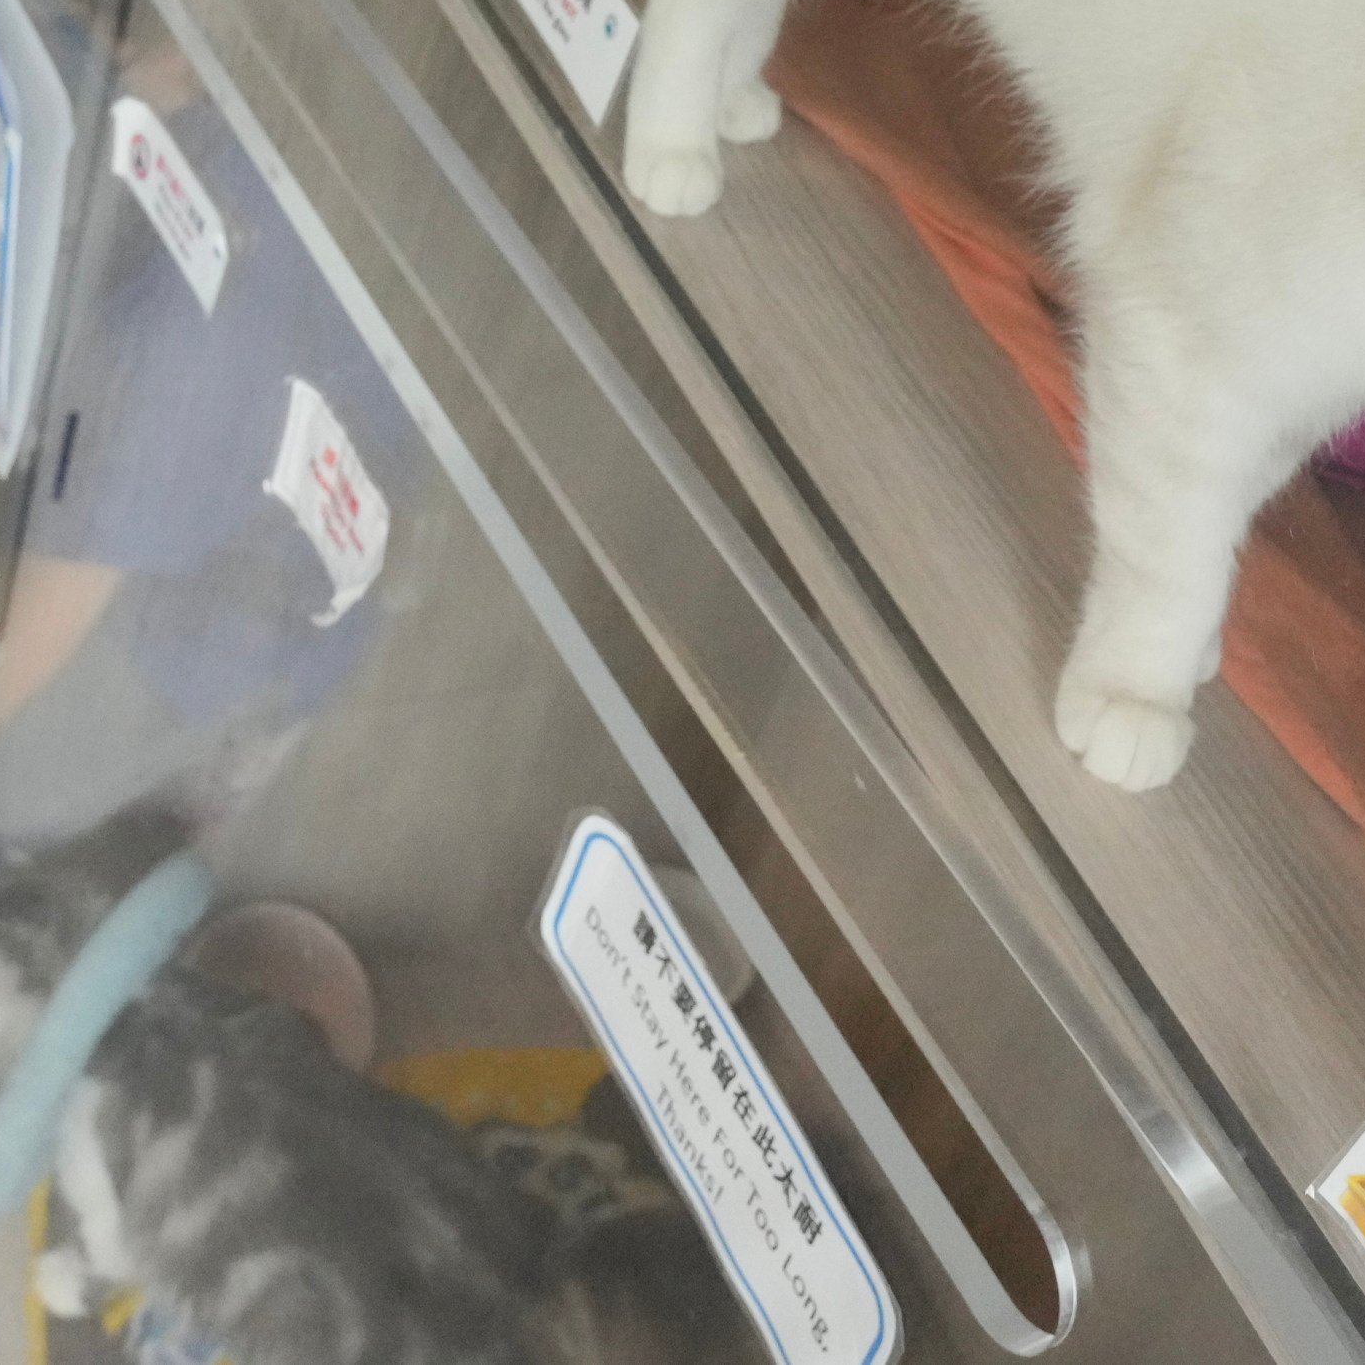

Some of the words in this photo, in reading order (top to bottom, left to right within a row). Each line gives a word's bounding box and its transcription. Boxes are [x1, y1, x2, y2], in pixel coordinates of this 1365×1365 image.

[585, 905, 633, 985] Don't
[633, 983, 669, 1050] Stay
[669, 1048, 710, 1126] Here
[712, 1126, 745, 1180] For
[746, 1181, 780, 1252] Too
